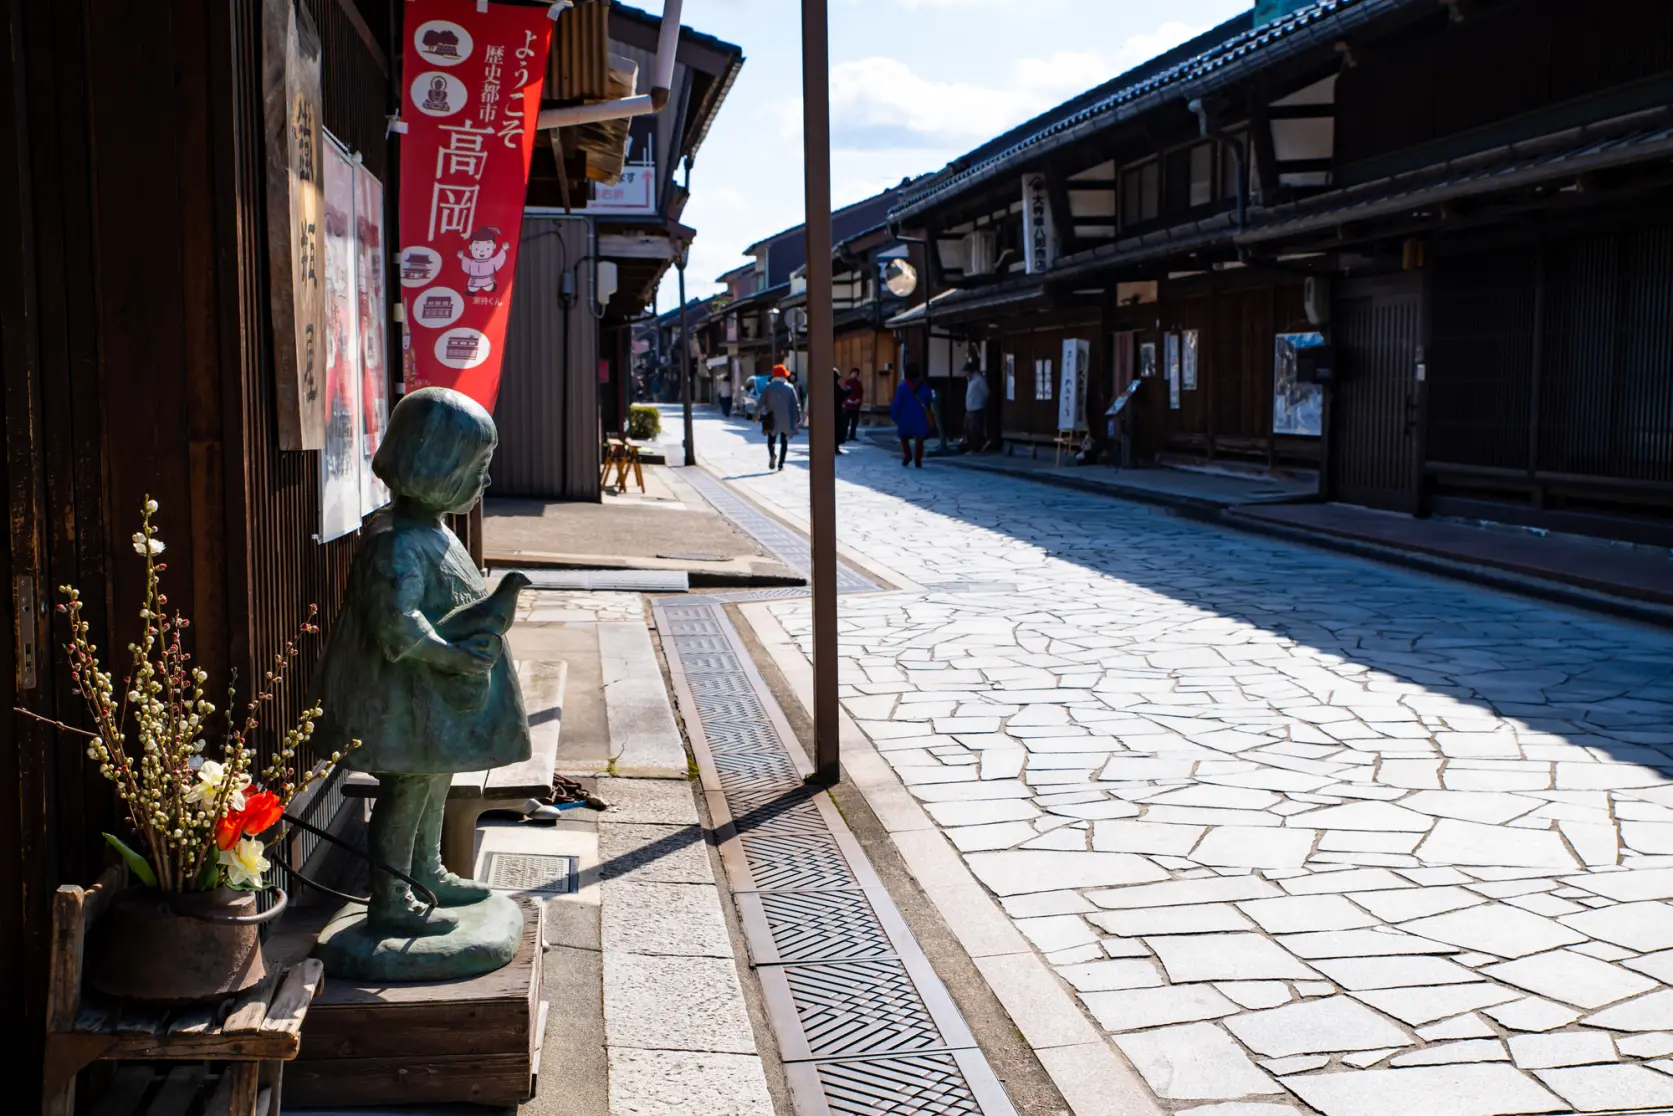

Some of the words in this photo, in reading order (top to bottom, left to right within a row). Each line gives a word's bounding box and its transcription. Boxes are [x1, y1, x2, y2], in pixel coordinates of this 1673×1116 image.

[479, 44, 505, 123] 歴史都市
[497, 30, 537, 148] ようこそ
[428, 118, 495, 242] 高岡
